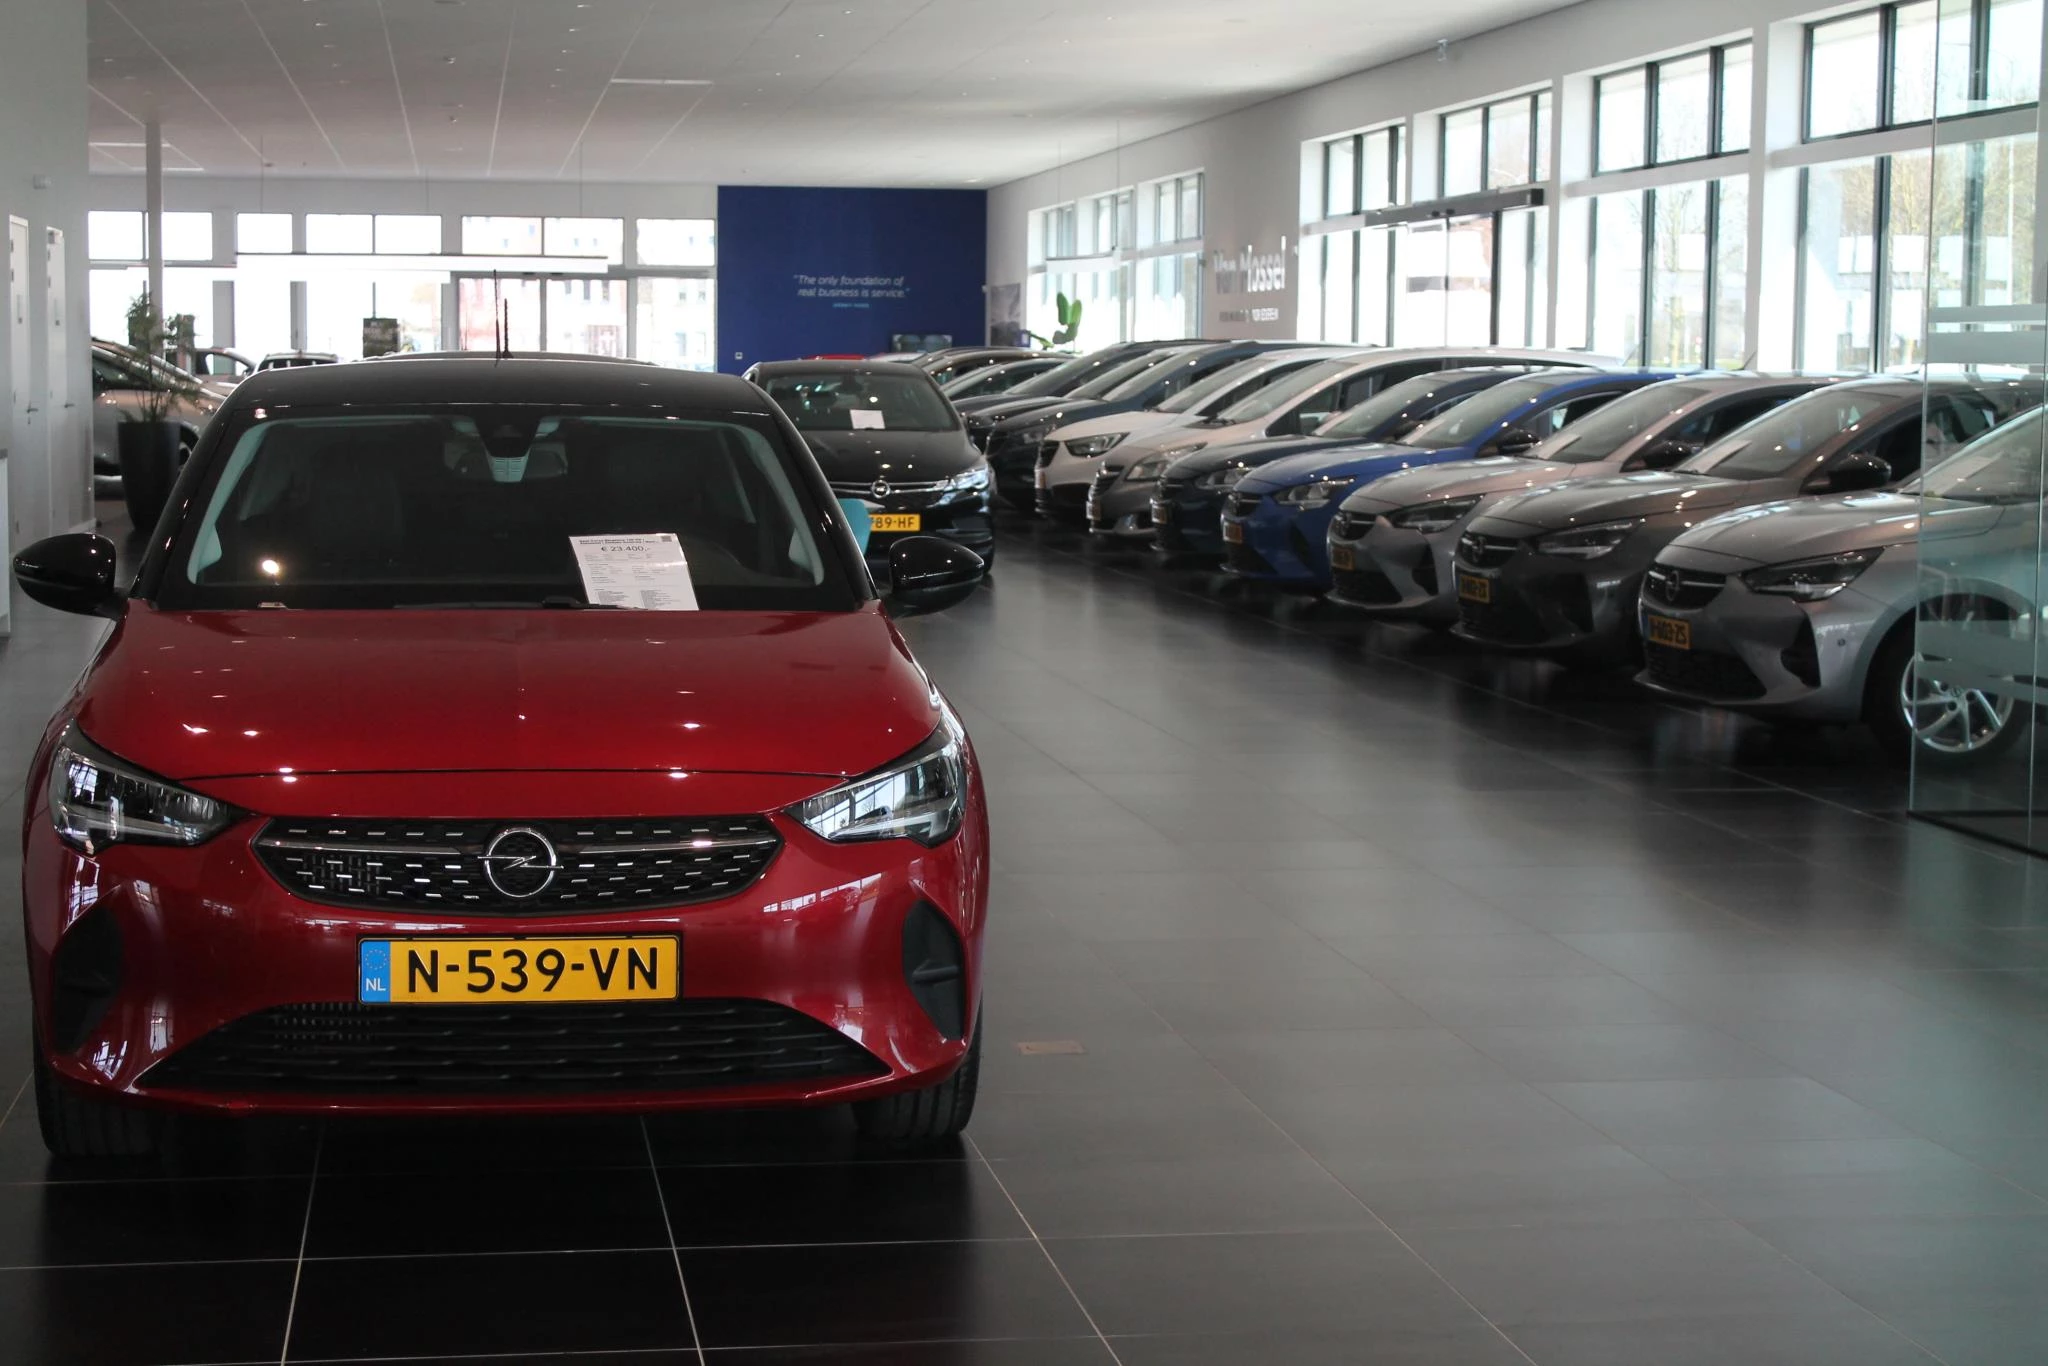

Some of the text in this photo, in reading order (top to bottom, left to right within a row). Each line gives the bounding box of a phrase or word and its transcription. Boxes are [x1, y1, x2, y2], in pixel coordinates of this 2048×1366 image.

[818, 275, 838, 286] only
[840, 275, 891, 286] foundation
[893, 275, 905, 287] of
[797, 287, 817, 297] real
[818, 287, 859, 298] business
[860, 288, 869, 297] is
[408, 947, 658, 993] N-539-VN
[365, 978, 387, 992] NL
